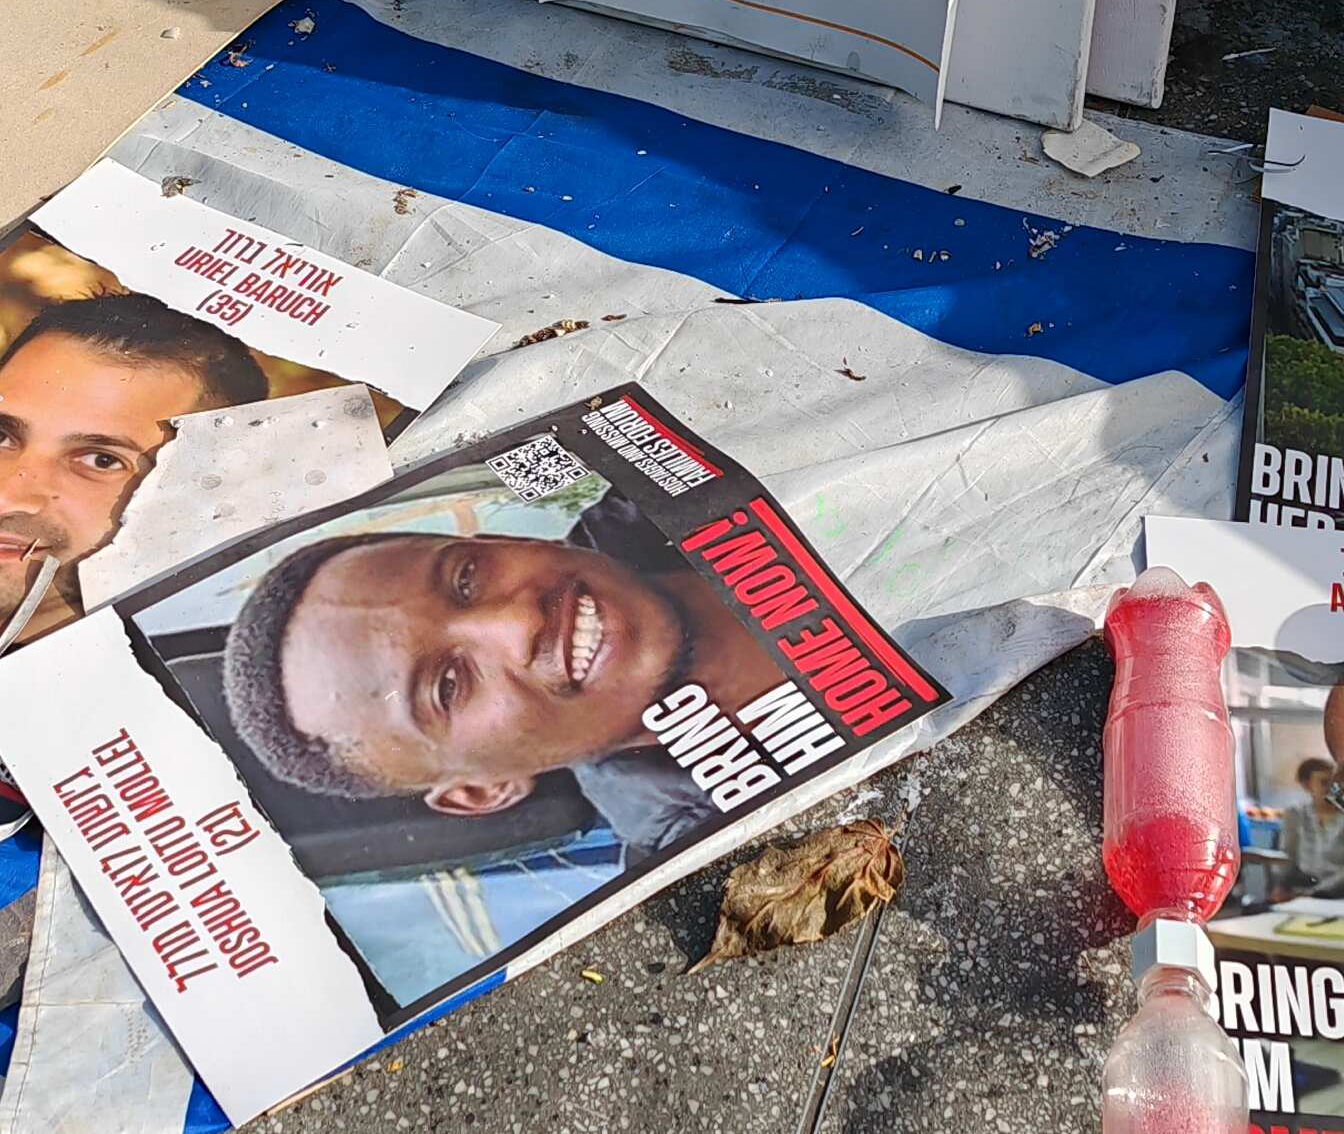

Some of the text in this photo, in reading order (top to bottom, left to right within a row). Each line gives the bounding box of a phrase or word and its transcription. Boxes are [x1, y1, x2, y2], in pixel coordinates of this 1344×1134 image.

[174, 245, 332, 326] URIEL BARUCH
[196, 289, 254, 326] (35)
[211, 228, 344, 297] אוריאל ברוך
[581, 410, 690, 498] HOSTAGES AND MISSING
[599, 397, 716, 488] FAMILIES FORUM
[681, 511, 912, 737] HOME NOW!
[641, 684, 782, 814] BRING
[735, 680, 847, 777] HIM
[92, 727, 279, 979] JOSHUA LOITU MOLLEL
[196, 799, 261, 857] (21)
[99, 845, 180, 932] לואיטו
[151, 920, 218, 994] מולל
